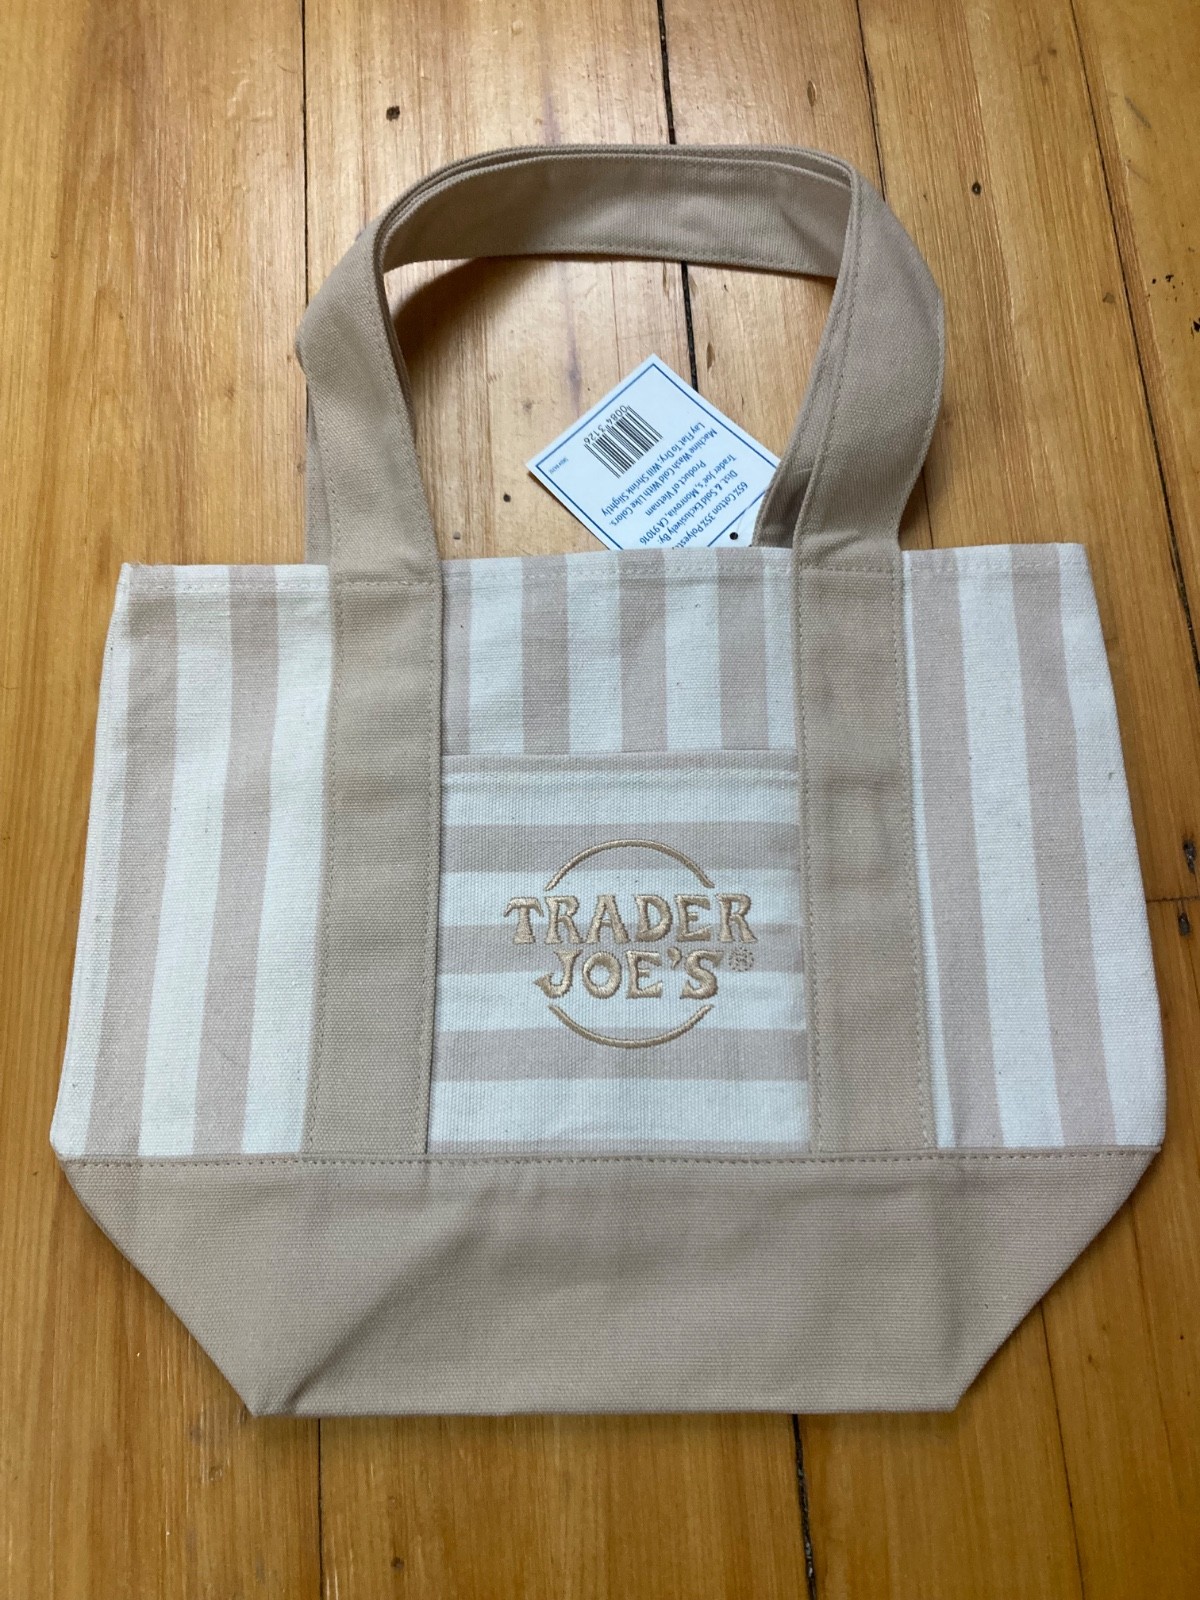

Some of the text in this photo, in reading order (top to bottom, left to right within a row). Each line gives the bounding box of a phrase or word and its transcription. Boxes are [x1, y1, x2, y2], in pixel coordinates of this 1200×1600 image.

[689, 421, 705, 434] Lay
[677, 431, 694, 446] Flat
[688, 427, 717, 453] Machine
[670, 443, 682, 452] To
[671, 452, 692, 469] Wash
[645, 462, 662, 477] Will
[657, 467, 675, 484] Cold
[625, 473, 649, 494] Shrink
[642, 480, 662, 496] With
[644, 459, 706, 516] Product of Vietnam
[600, 491, 629, 516] Slightly
[629, 493, 646, 508] Like
[639, 453, 736, 545] Trader Joe's, Monrovia, CA 91016
[699, 488, 718, 505] Sold
[666, 501, 704, 535] Exclusively
[671, 481, 748, 550] 65% Cotton 35% Polyest
[657, 532, 671, 544] By:
[503, 893, 758, 945] TRADER
